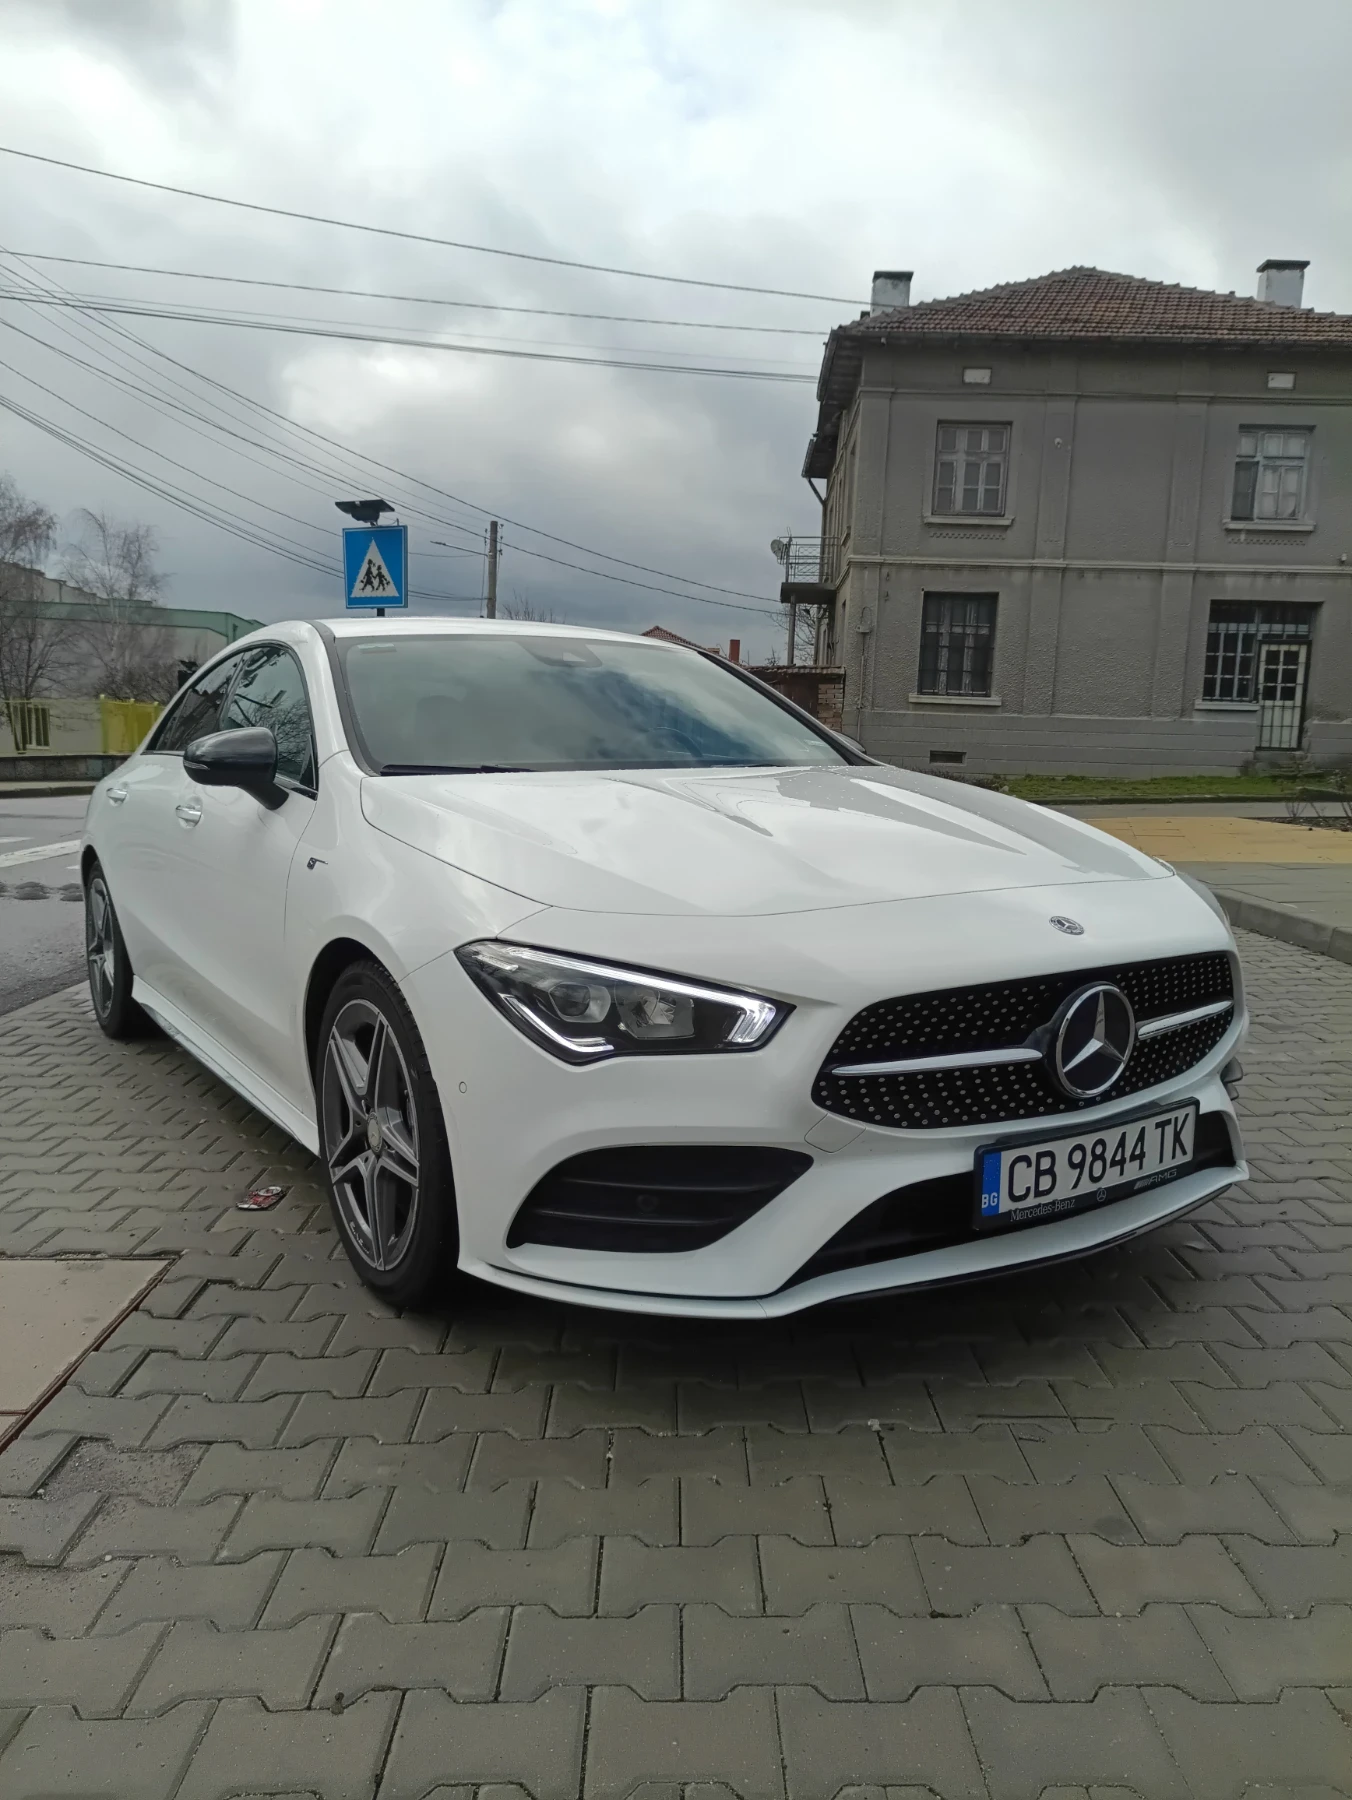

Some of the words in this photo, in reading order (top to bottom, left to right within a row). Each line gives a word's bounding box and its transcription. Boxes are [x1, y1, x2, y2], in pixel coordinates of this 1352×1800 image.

[1008, 1150, 1057, 1203] CB
[1067, 1126, 1146, 1190] 9844
[1155, 1113, 1190, 1164] TK
[1147, 1169, 1177, 1187] AMG
[981, 1192, 998, 1209] BG
[1010, 1199, 1076, 1222] Mercedes-Benz
